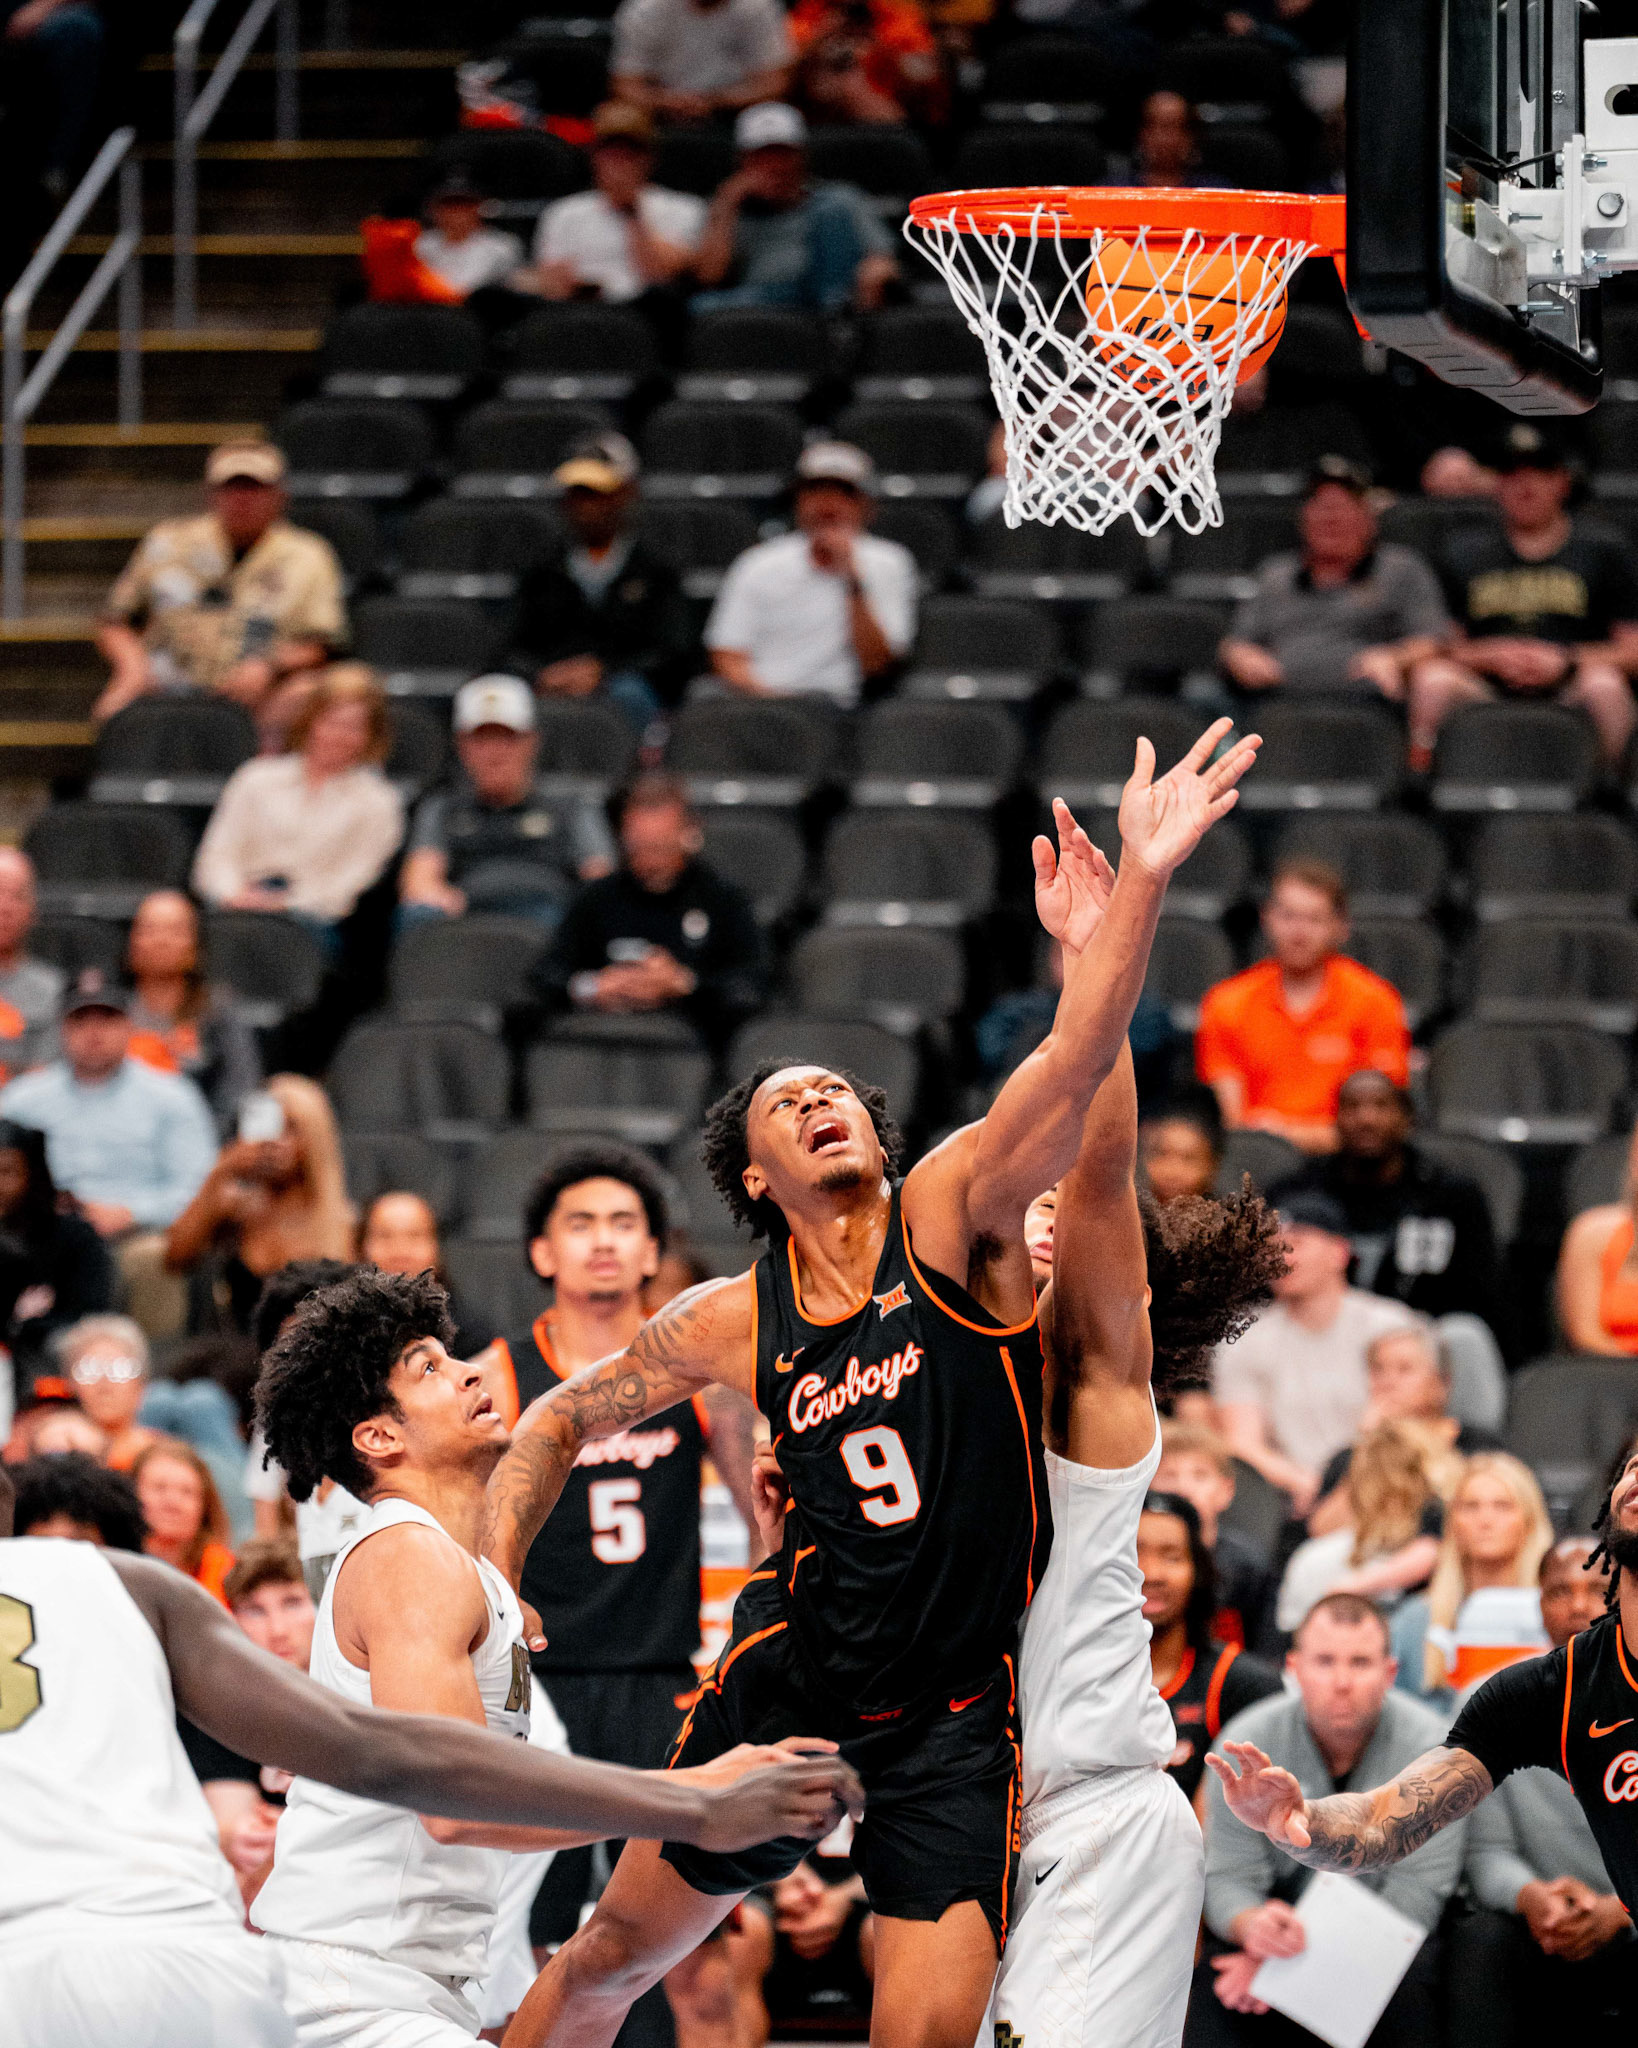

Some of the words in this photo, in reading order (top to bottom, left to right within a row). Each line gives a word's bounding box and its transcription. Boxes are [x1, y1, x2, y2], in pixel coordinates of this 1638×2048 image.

[788, 1341, 924, 1433] Cowboys
[588, 1477, 646, 1565] 5
[838, 1424, 922, 1528] 9
